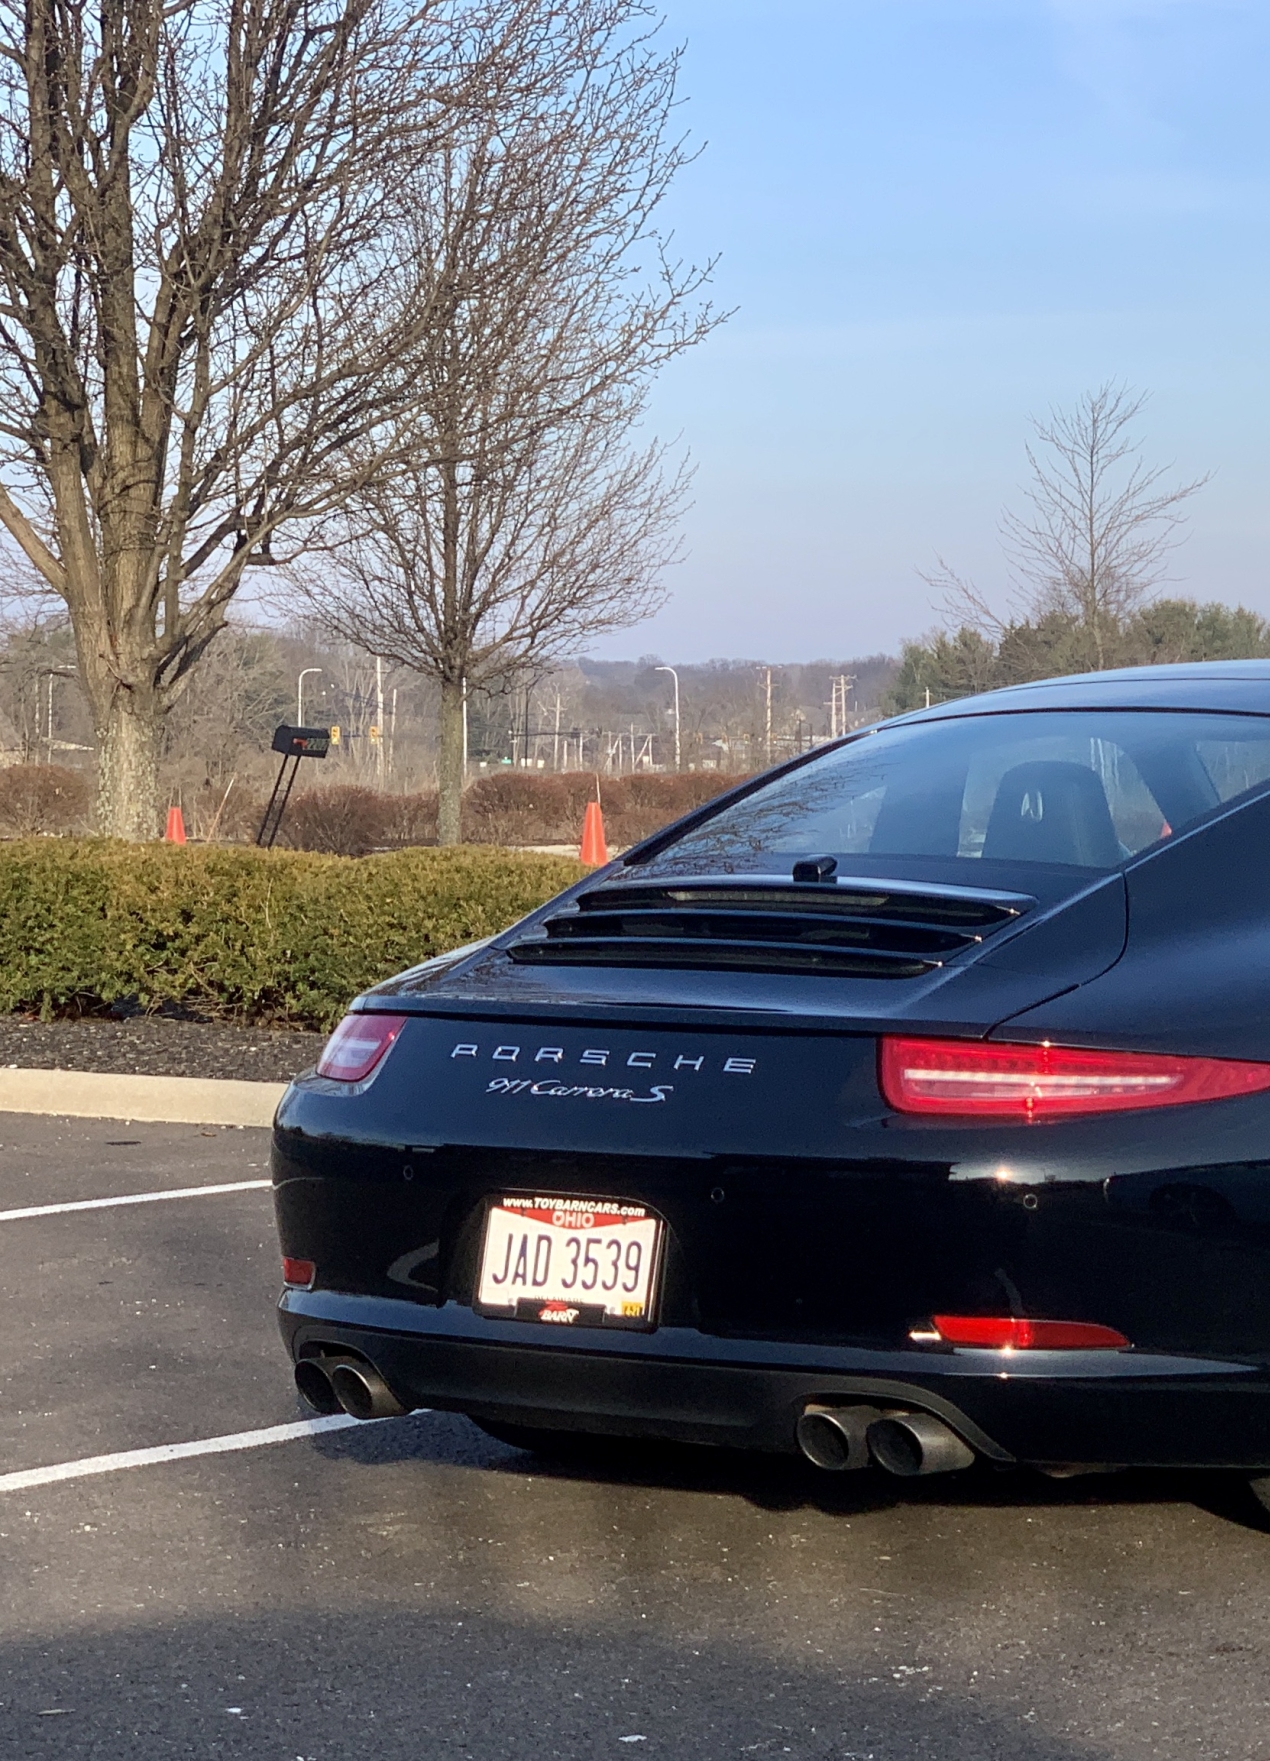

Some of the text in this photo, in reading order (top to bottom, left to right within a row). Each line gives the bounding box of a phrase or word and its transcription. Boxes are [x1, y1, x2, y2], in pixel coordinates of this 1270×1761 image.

[451, 1043, 757, 1074] PORSCHE
[486, 1077, 674, 1102] 911 Carrera S
[502, 1196, 646, 1218] www.TOYBARNCARS.com
[552, 1212, 595, 1229] OHIO
[492, 1232, 643, 1293] JAD 3539
[540, 1307, 580, 1324] BARN
